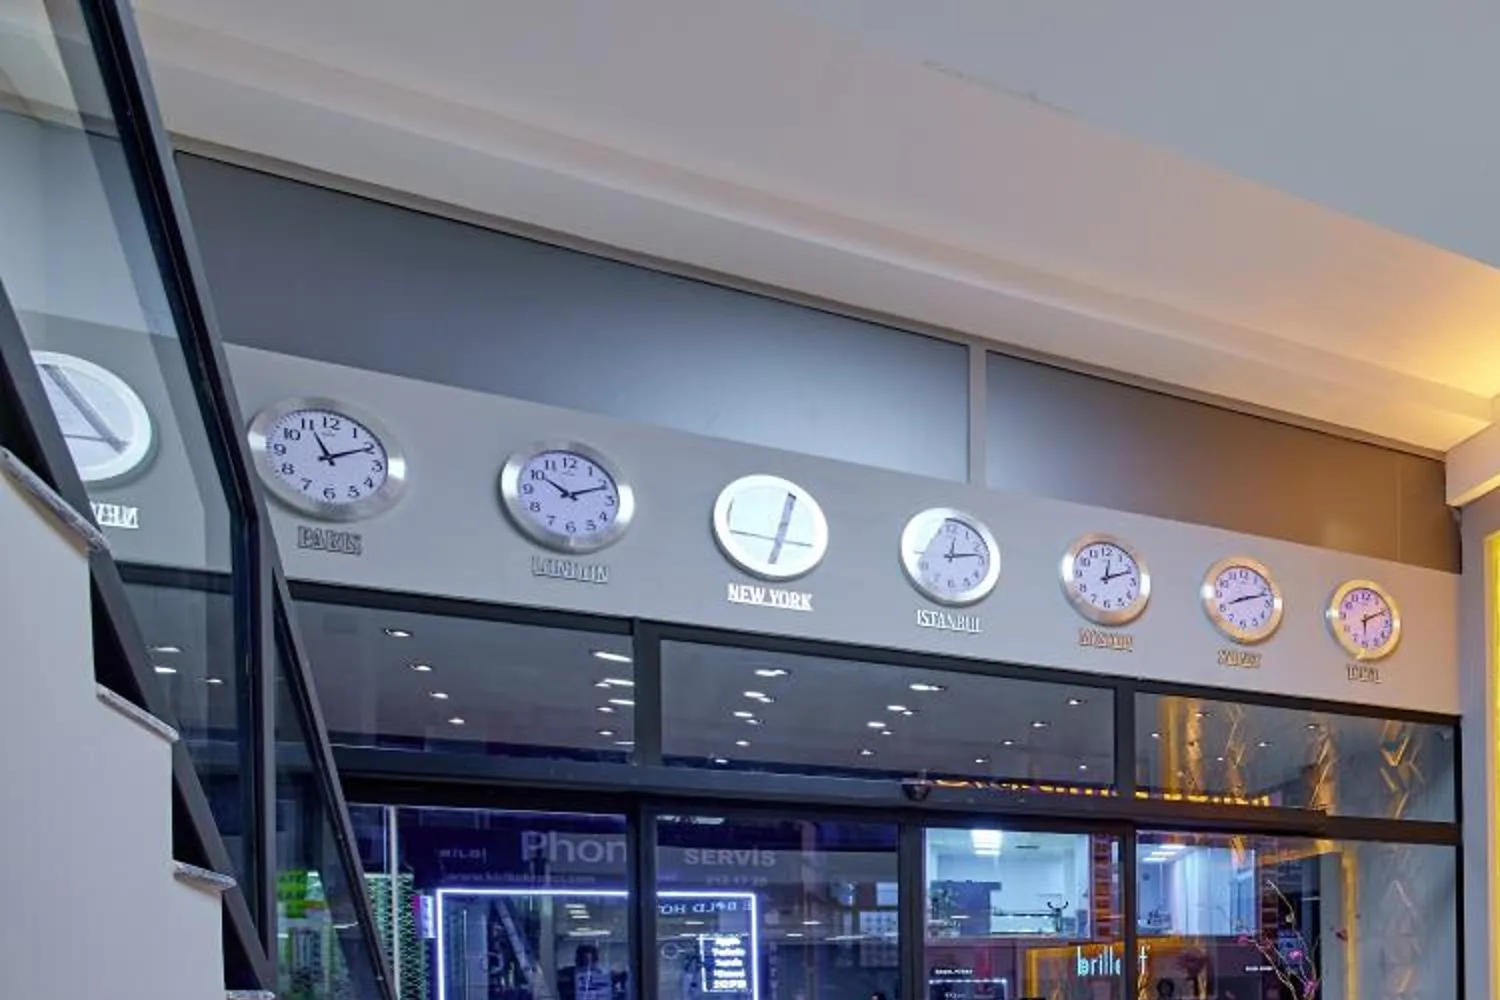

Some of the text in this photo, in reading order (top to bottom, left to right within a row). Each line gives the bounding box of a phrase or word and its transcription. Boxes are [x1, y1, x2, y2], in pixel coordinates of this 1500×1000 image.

[301, 418, 314, 430] 11
[322, 416, 340, 430] 12
[284, 428, 300, 440] 10
[352, 428, 358, 438] 1
[274, 444, 286, 456] 9
[363, 442, 374, 454] 2
[282, 463, 295, 474] 8
[372, 460, 383, 472] 3
[544, 460, 556, 471] 11
[563, 457, 576, 469] 12
[530, 469, 545, 480] 10
[588, 466, 593, 476] 1
[301, 478, 312, 490] 7
[363, 477, 374, 488] 4
[523, 483, 534, 494] 9
[598, 479, 608, 490] 2
[324, 488, 336, 500] 6
[348, 486, 360, 498] 5
[530, 502, 541, 512] 8
[605, 496, 614, 506] 3
[547, 515, 556, 526] 7
[600, 512, 608, 522] 4
[566, 521, 576, 533] 6
[586, 520, 596, 530] 5
[298, 526, 362, 555] PARIS
[531, 556, 608, 584] LONDON
[728, 583, 813, 611] NEW YORK
[917, 609, 983, 633] ISTANBUL
[521, 830, 626, 863] Phon
